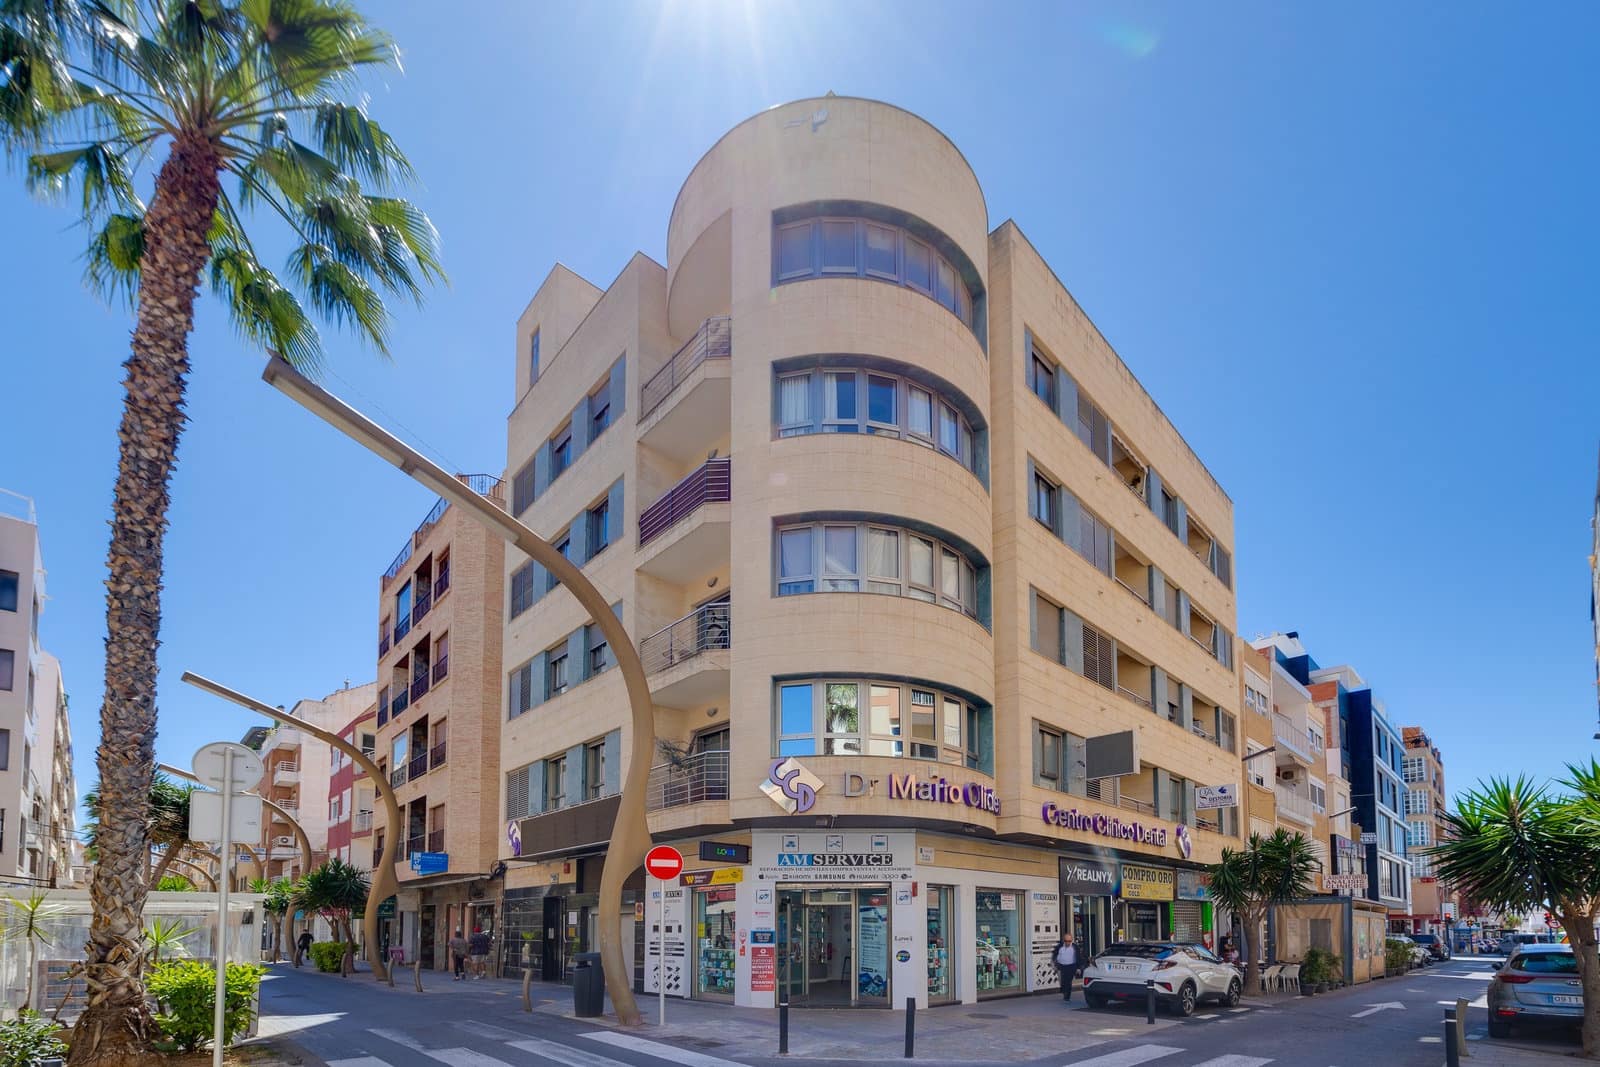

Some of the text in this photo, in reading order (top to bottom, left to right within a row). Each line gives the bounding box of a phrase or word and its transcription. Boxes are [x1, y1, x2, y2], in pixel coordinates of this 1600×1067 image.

[844, 771, 879, 798] Dr
[889, 773, 961, 804] Mario
[1042, 801, 1092, 831] Centro
[1134, 822, 1168, 847] Dental
[779, 854, 893, 866] AM SERVICE
[1077, 868, 1113, 883] REALNYX
[1123, 867, 1156, 882] COMPRO
[1158, 871, 1173, 884] ORO
